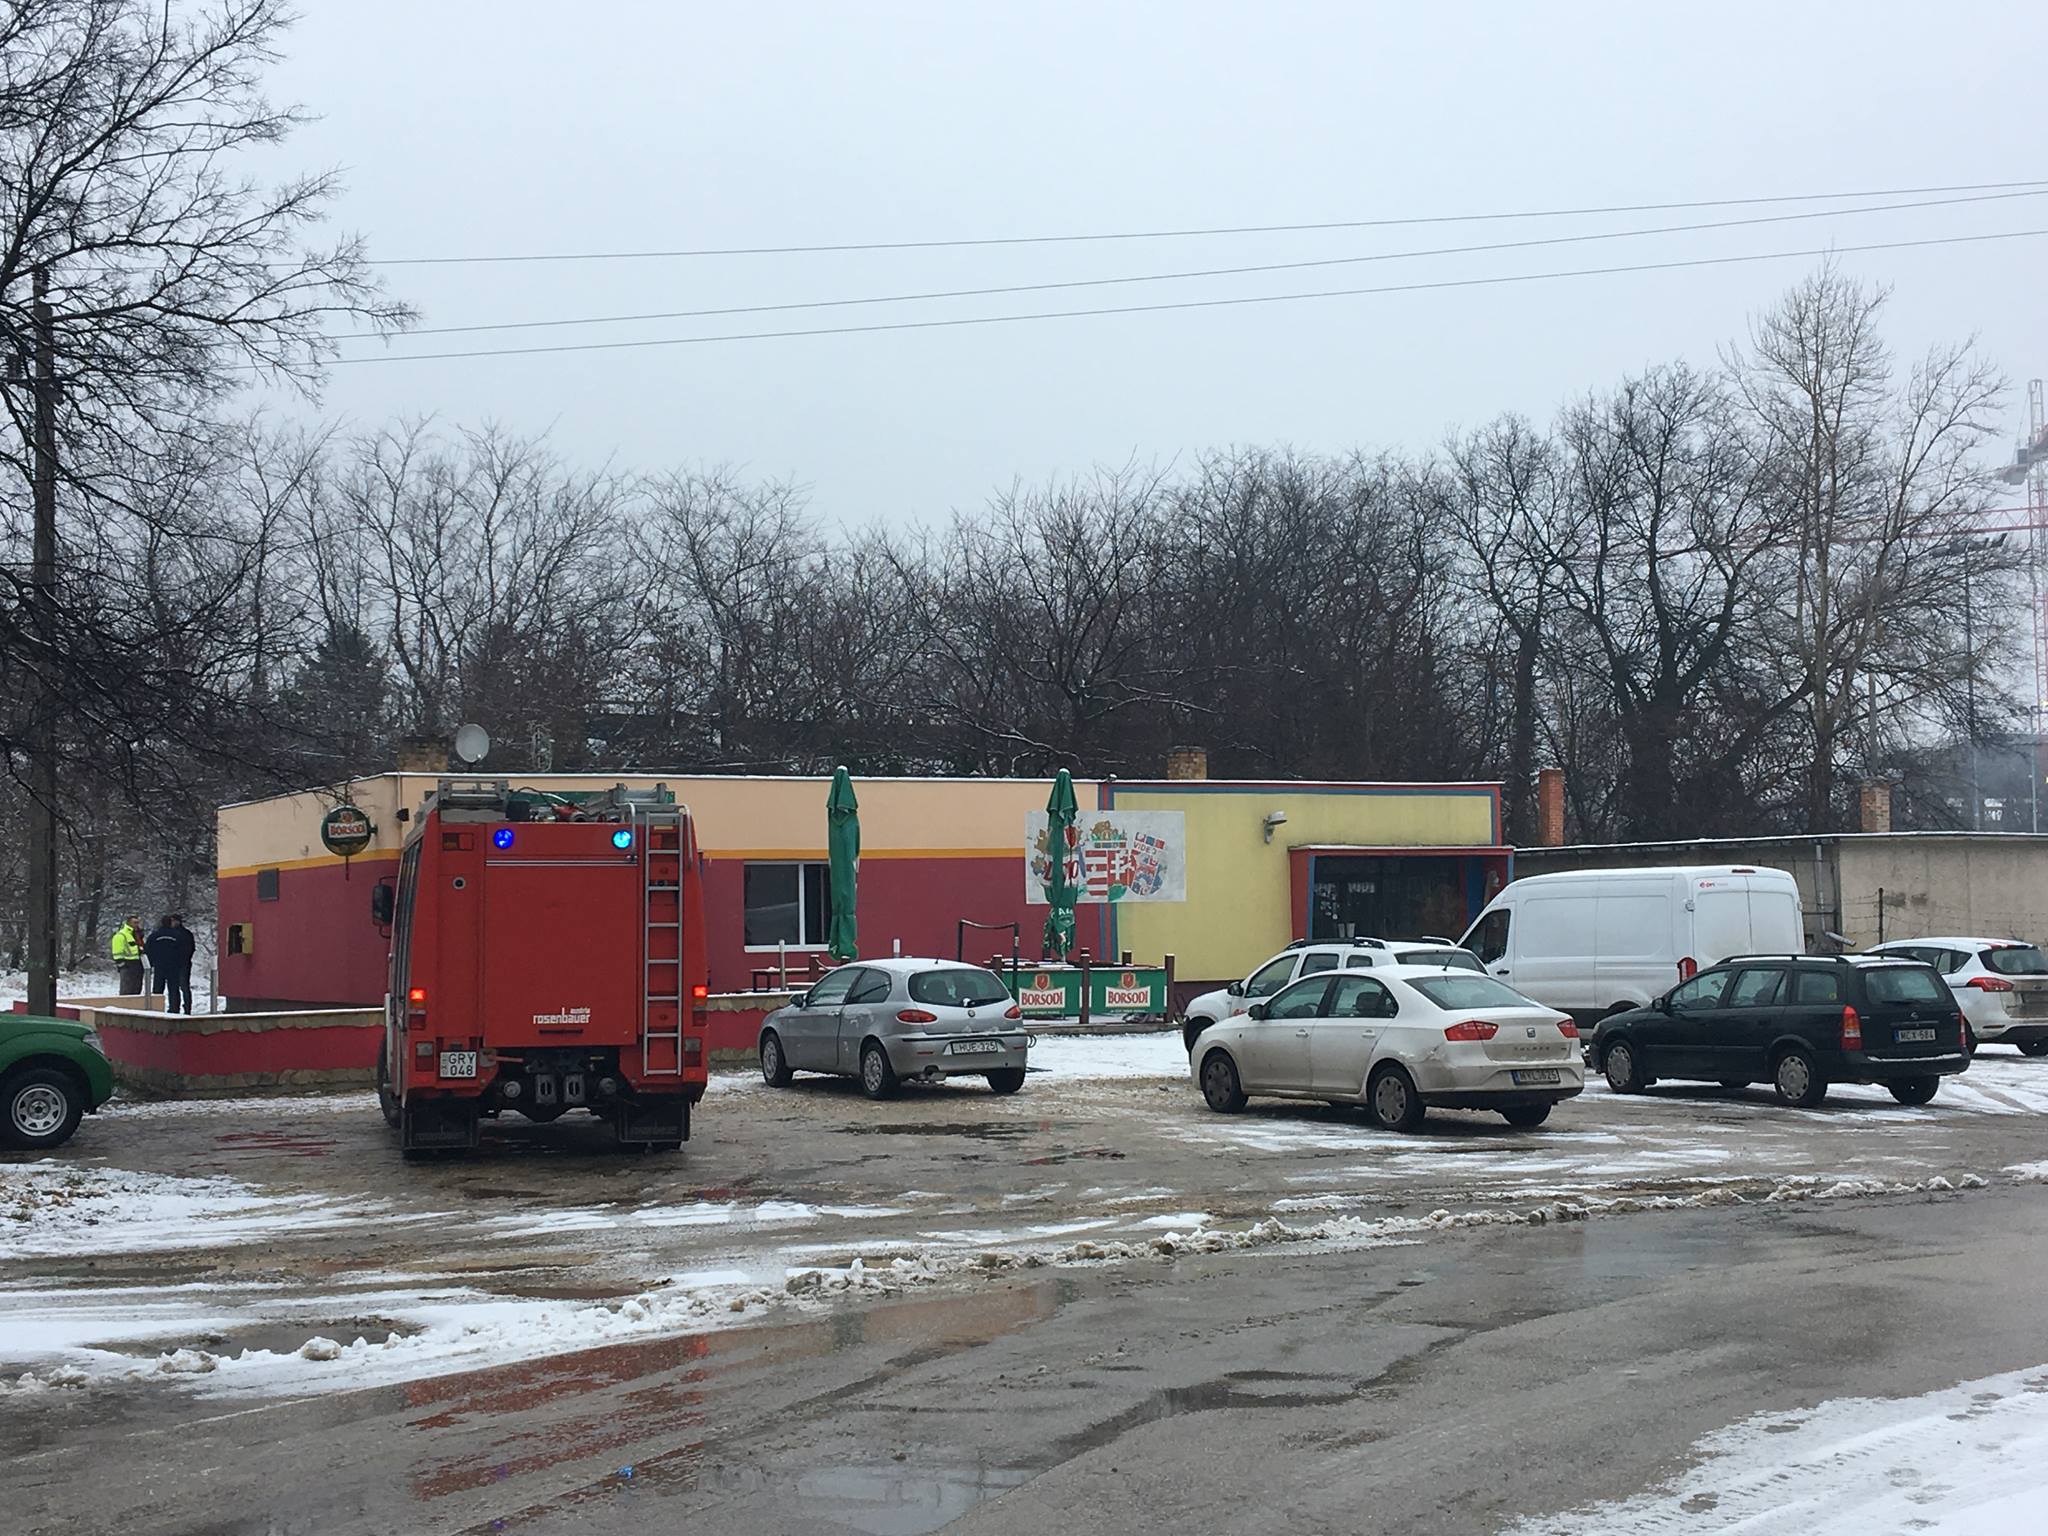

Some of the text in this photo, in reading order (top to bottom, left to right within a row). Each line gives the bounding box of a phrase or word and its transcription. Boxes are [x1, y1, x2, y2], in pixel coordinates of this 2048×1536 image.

[1021, 991, 1063, 1006] BORSODI
[1107, 990, 1149, 1004] BORSODI
[533, 1007, 591, 1024] rosenbauer
[448, 1053, 475, 1064] GRY
[450, 1064, 473, 1076] 048
